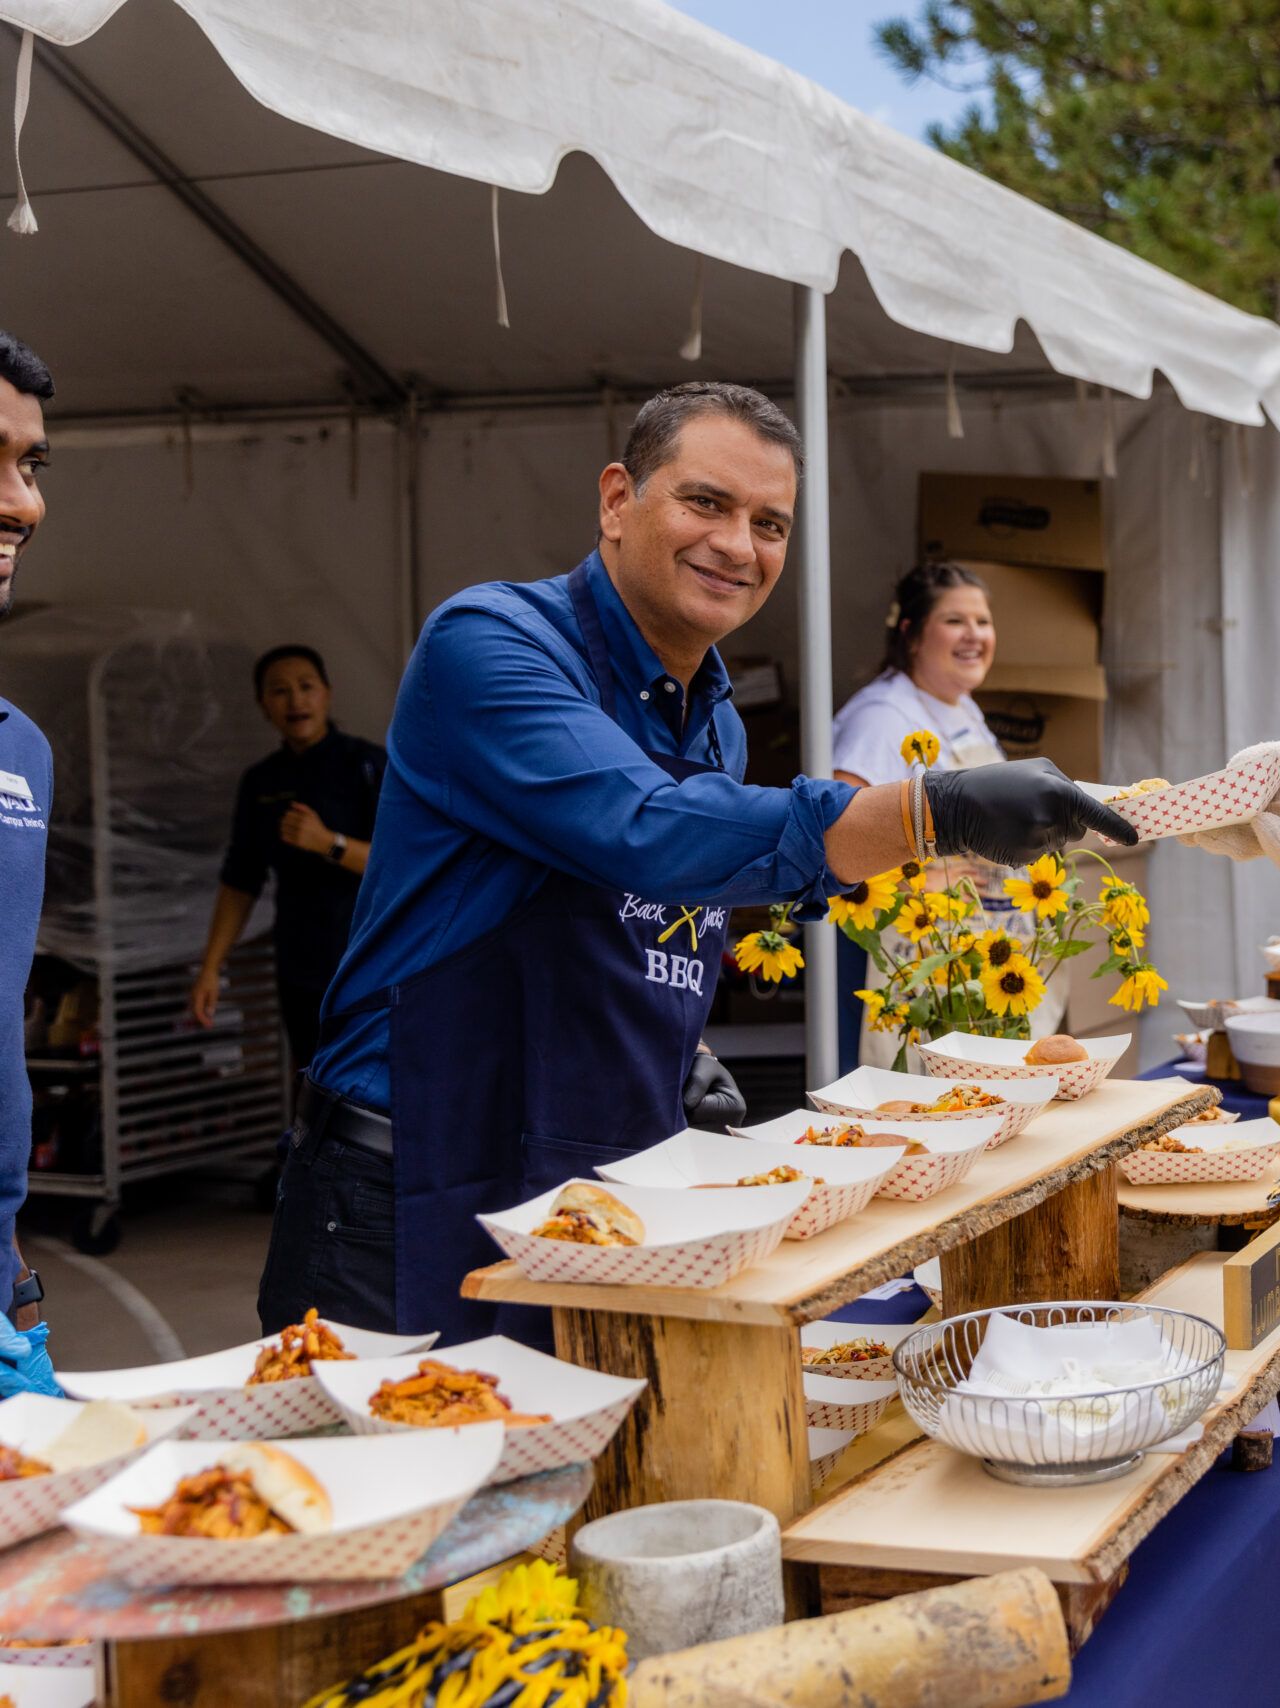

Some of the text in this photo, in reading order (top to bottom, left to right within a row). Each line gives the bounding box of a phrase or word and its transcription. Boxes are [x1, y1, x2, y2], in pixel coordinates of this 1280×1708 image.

[619, 893, 726, 938] Back Jacks
[645, 948, 704, 997] BBQ
